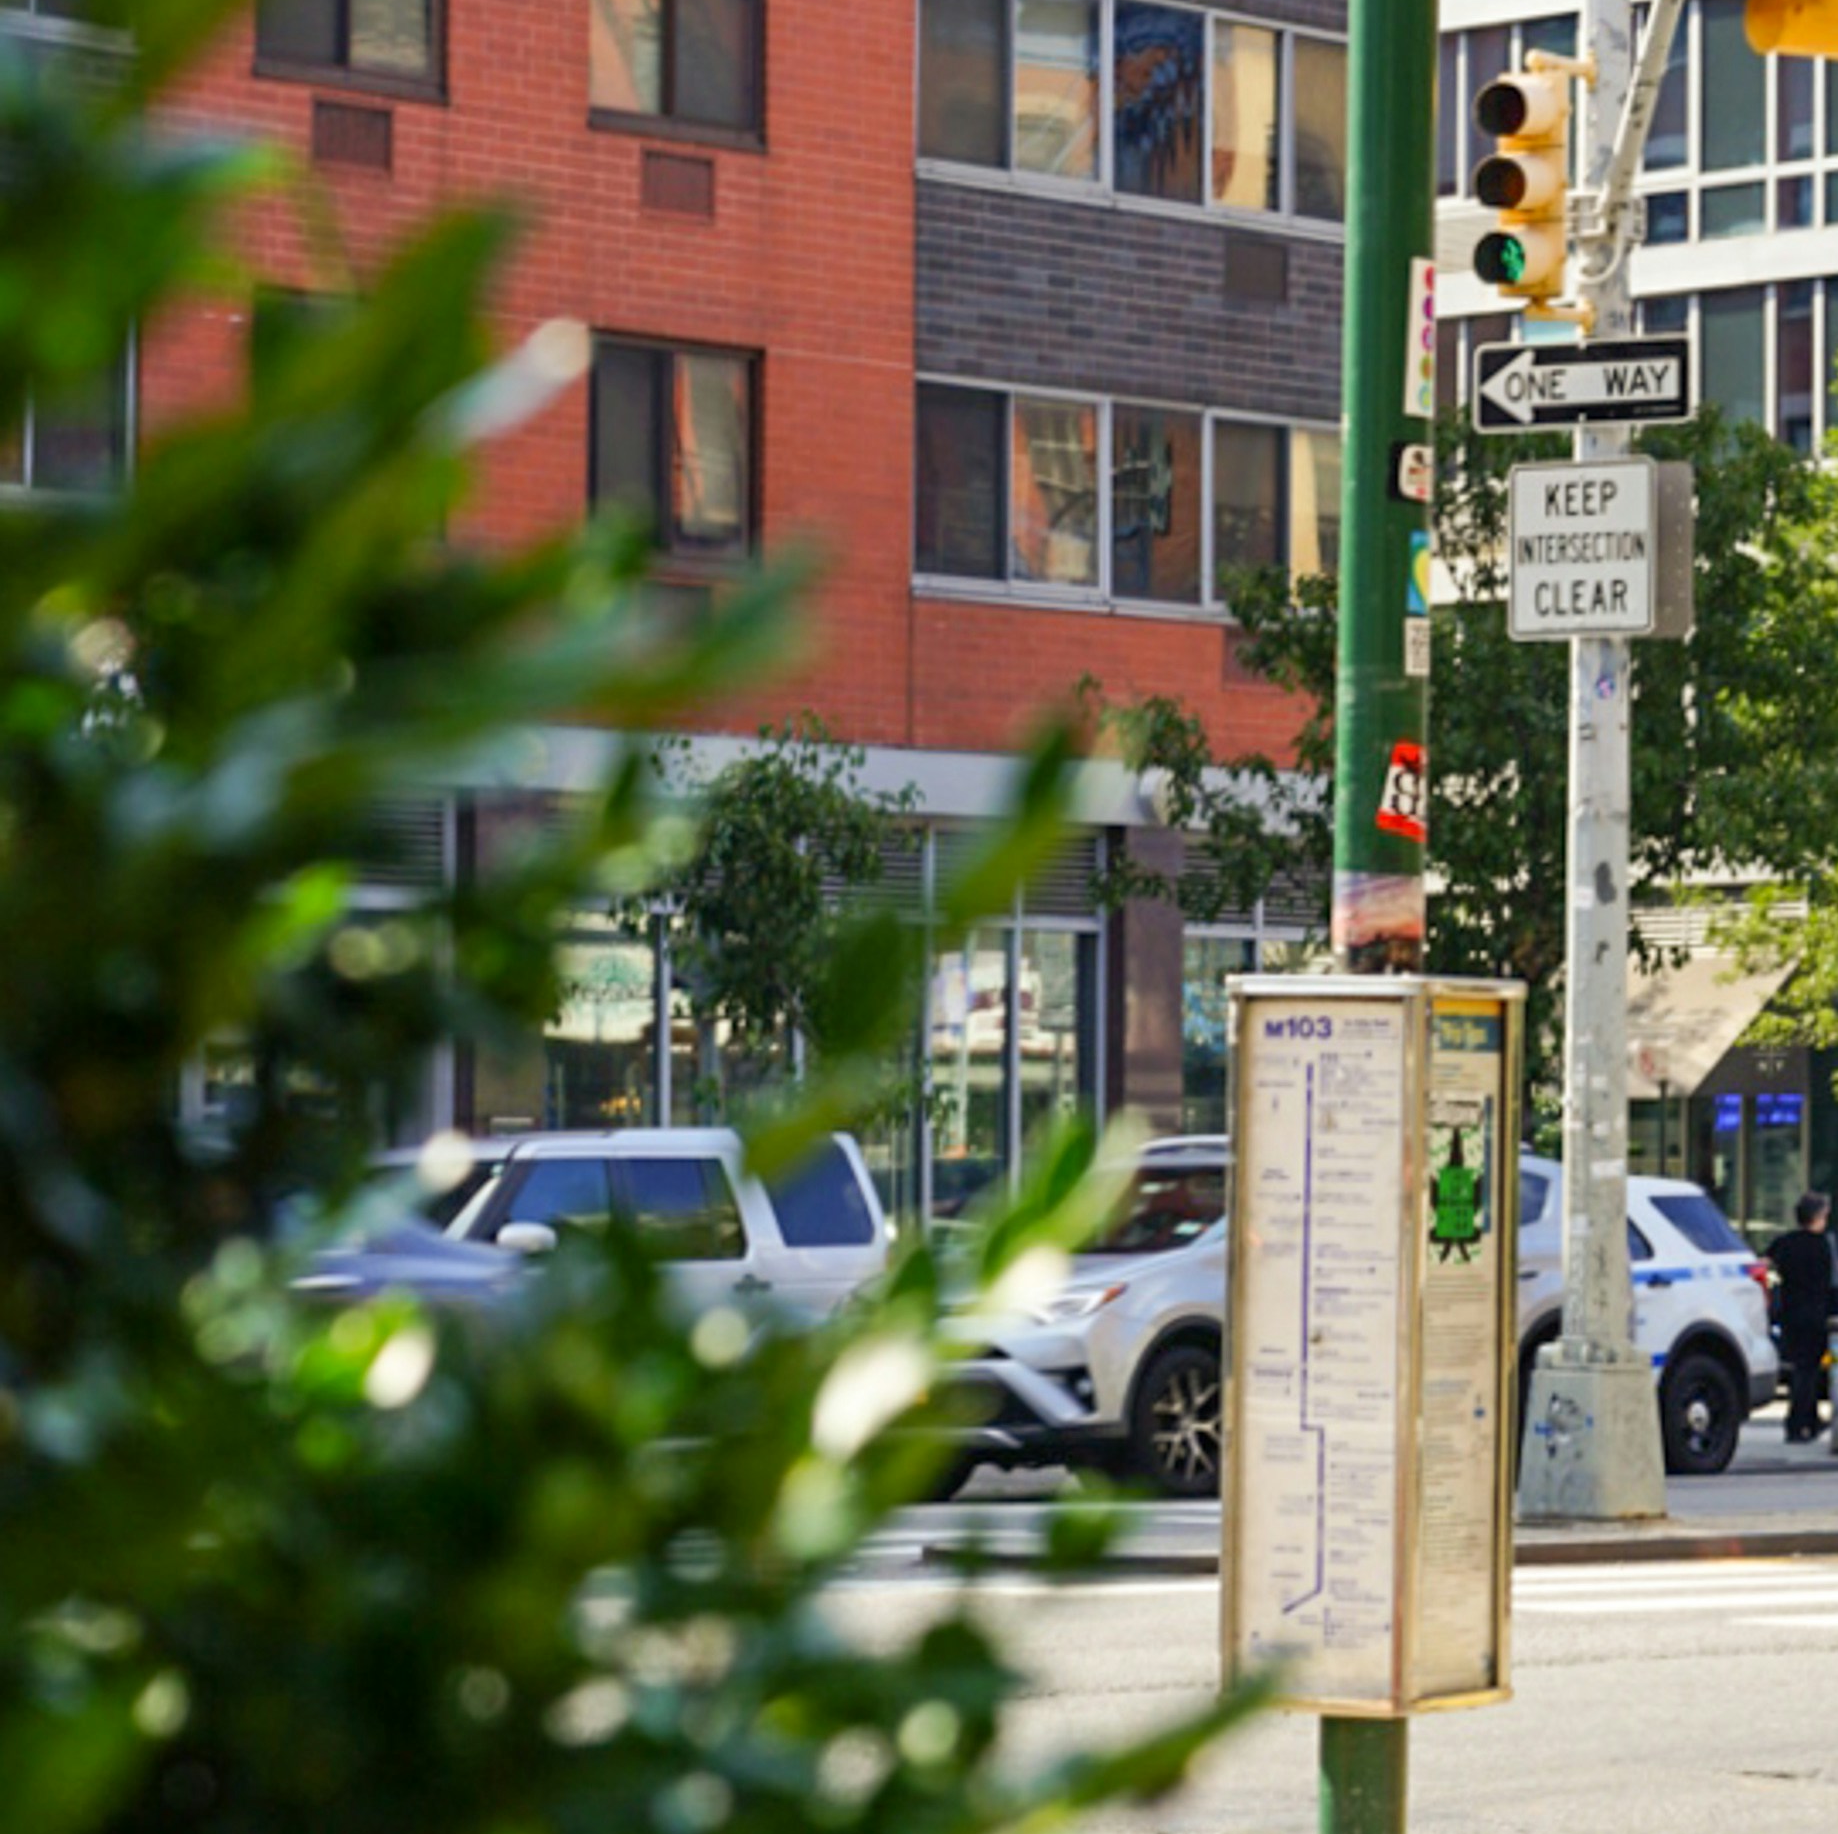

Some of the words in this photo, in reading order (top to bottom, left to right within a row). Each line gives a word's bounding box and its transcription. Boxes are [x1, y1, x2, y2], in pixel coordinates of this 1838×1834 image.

[1504, 371, 1567, 403] ONE
[1602, 365, 1670, 397] WAY
[1545, 479, 1618, 517] KEEP
[1517, 531, 1646, 565] INTERSECTION
[1534, 578, 1629, 617] CLEAR
[1264, 1016, 1333, 1040] M103
